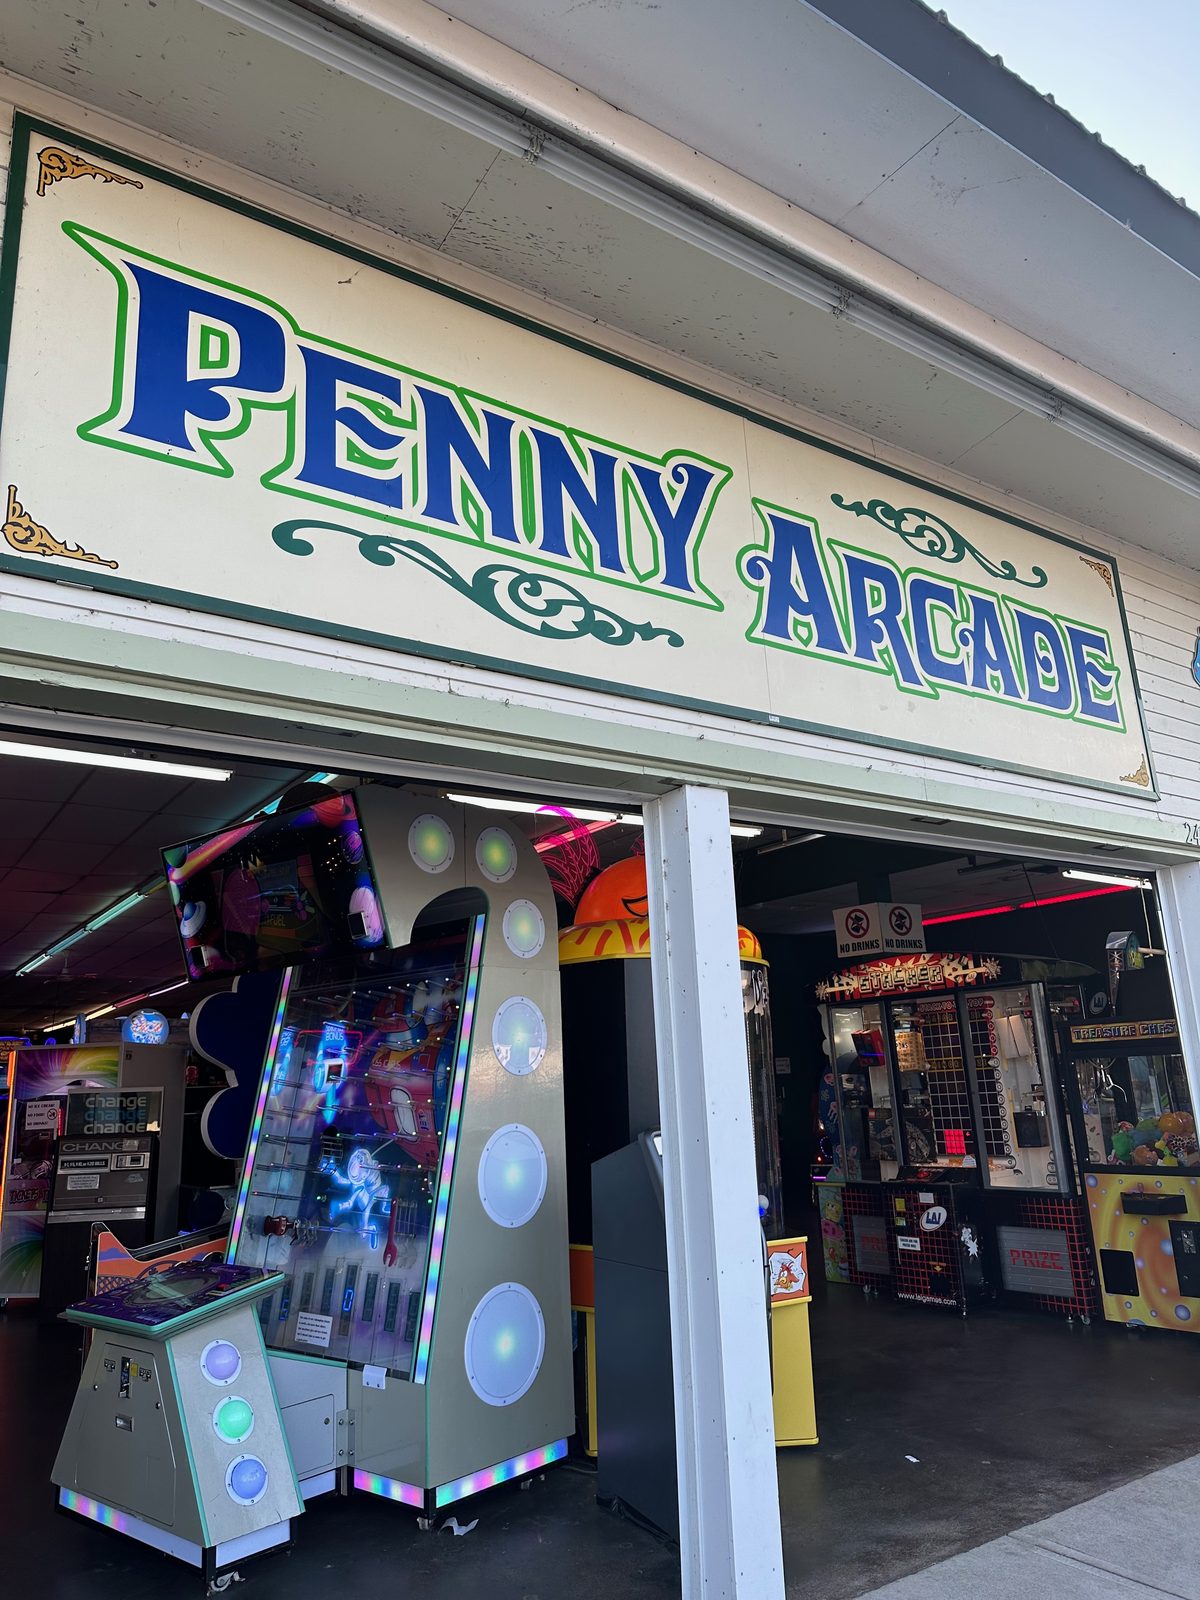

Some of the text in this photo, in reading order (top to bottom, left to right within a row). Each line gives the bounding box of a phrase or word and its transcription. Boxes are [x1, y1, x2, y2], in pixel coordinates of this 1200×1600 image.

[61, 221, 1126, 733] PENNY ARCADE
[840, 940, 880, 953] NO DRINKS
[885, 938, 923, 949] NO DRINKS
[858, 963, 944, 993] STACKER
[325, 1032, 344, 1041] BONUS
[1072, 1025, 1137, 1040] TREASURE
[86, 1097, 147, 1110] change
[85, 1109, 146, 1122] change
[84, 1121, 145, 1135] change
[62, 1142, 124, 1152] CHAN
[925, 1211, 941, 1225] LAI
[861, 1235, 887, 1250] PRI
[1009, 1248, 1064, 1270] PRIZE
[897, 1291, 957, 1306] www.laigames.com
